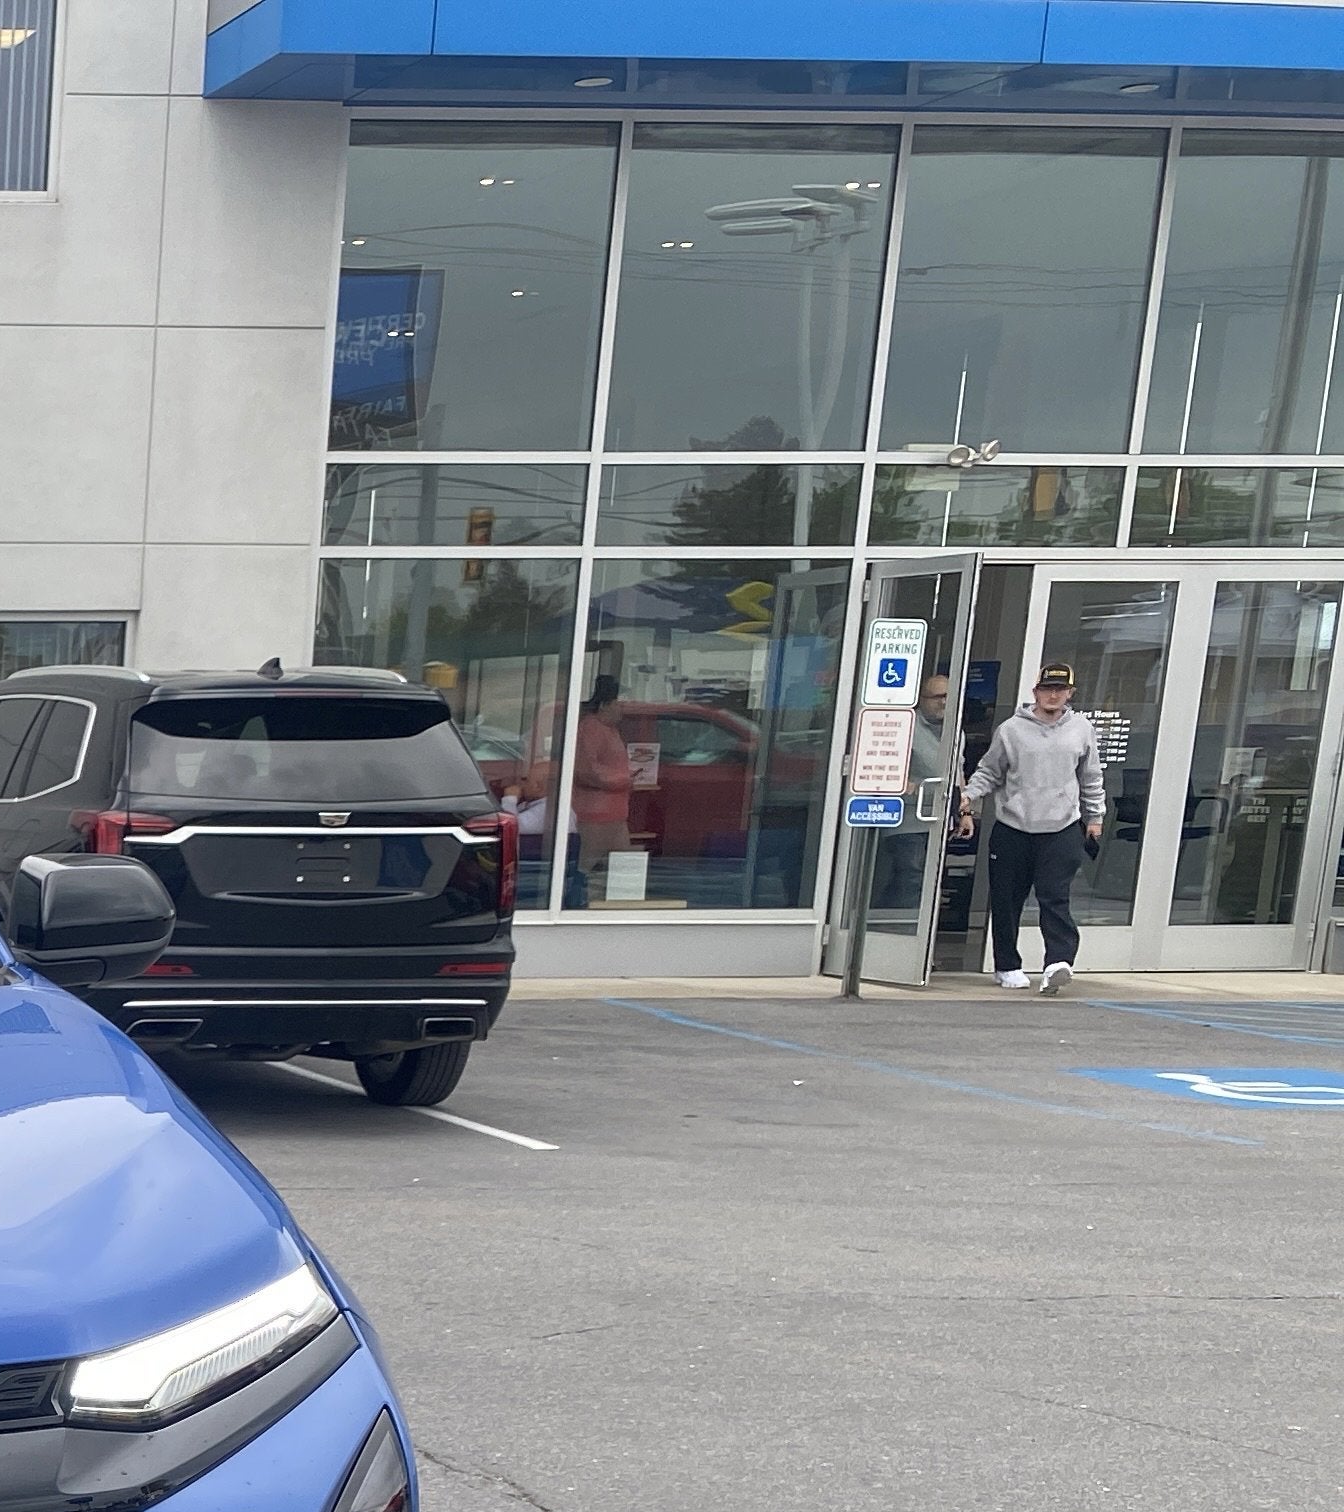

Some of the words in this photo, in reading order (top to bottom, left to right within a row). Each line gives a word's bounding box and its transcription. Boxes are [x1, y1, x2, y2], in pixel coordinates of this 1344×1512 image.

[875, 628, 921, 640] RESERVED
[874, 643, 918, 654] PARKING
[868, 803, 884, 812] VAN
[850, 812, 900, 821] ACCESSIBLE
